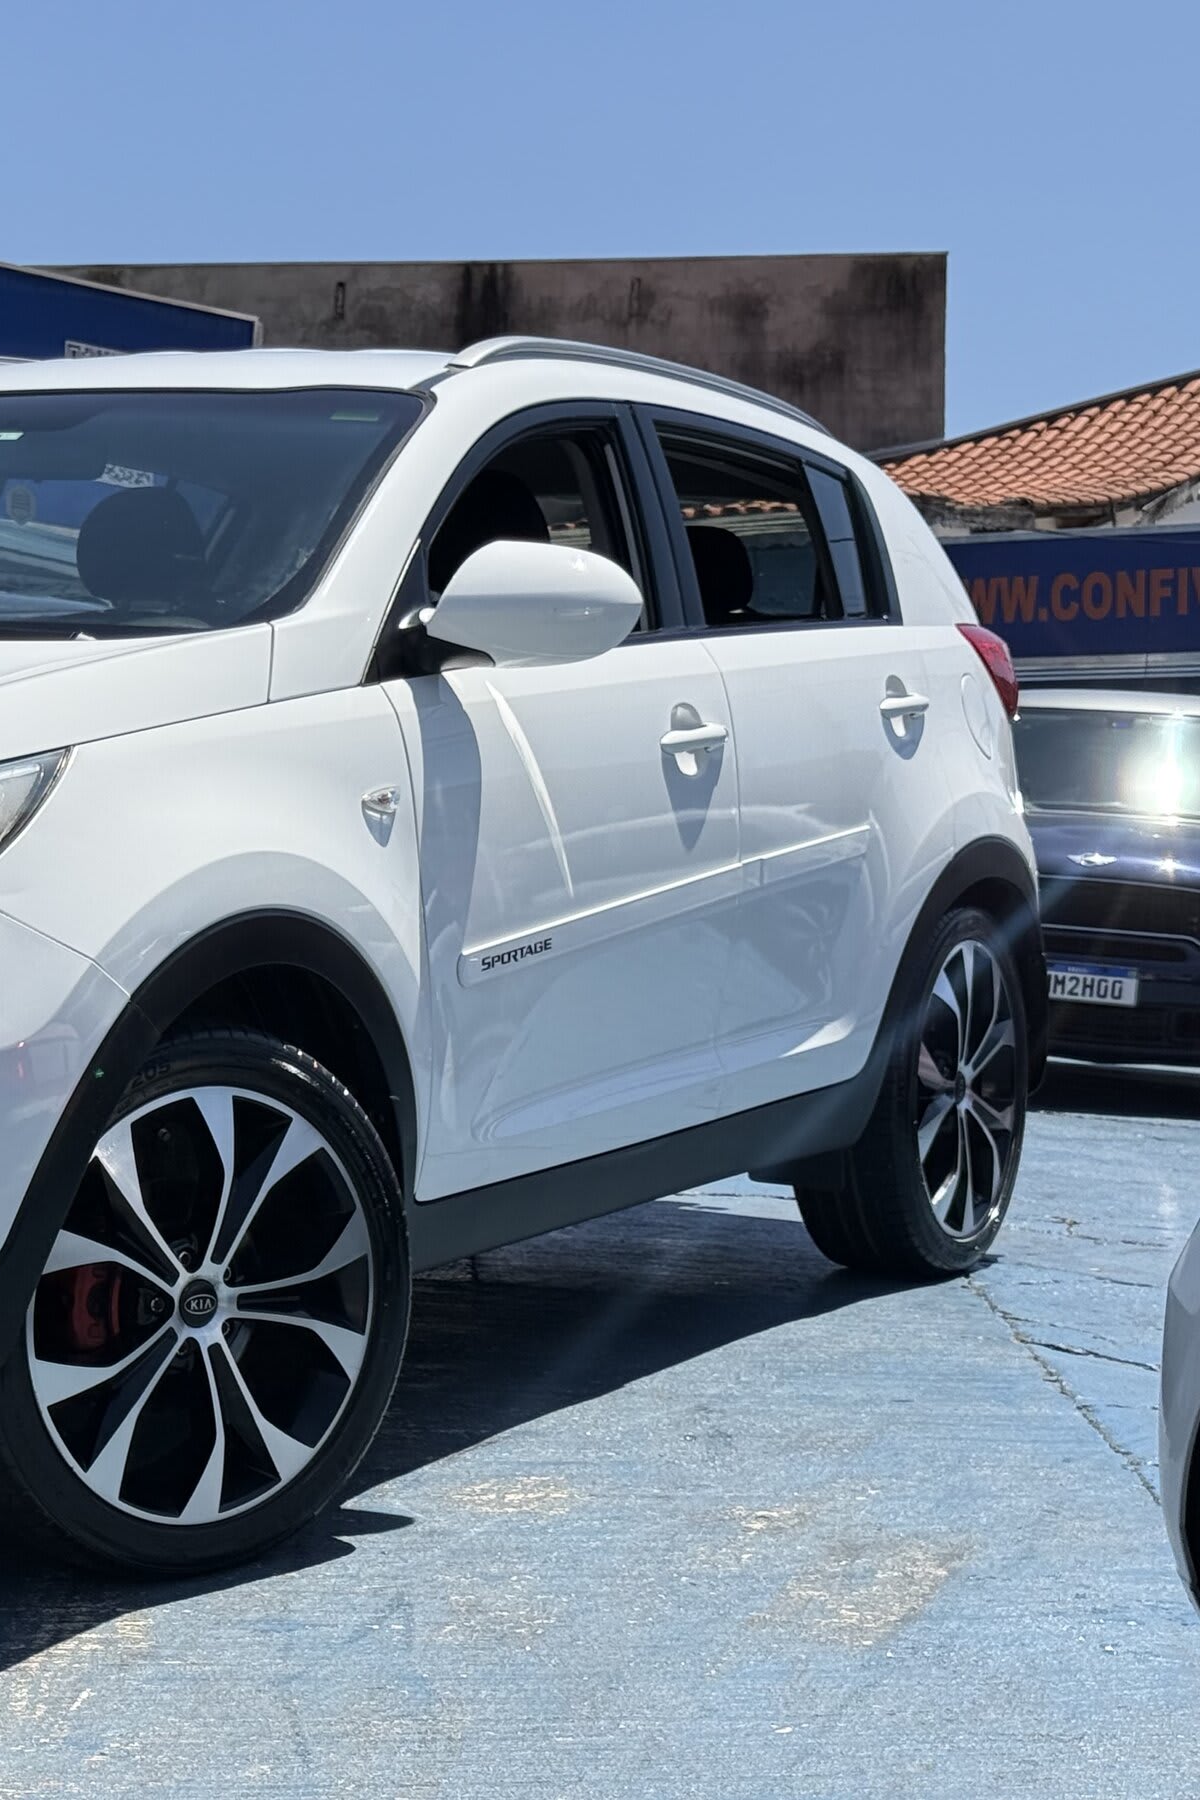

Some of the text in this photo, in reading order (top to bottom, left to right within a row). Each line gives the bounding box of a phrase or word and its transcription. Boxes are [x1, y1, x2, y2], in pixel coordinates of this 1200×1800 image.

[481, 938, 552, 973] SPORTAGE
[1048, 973, 1123, 1000] M2H00
[190, 1299, 211, 1310] KIA
